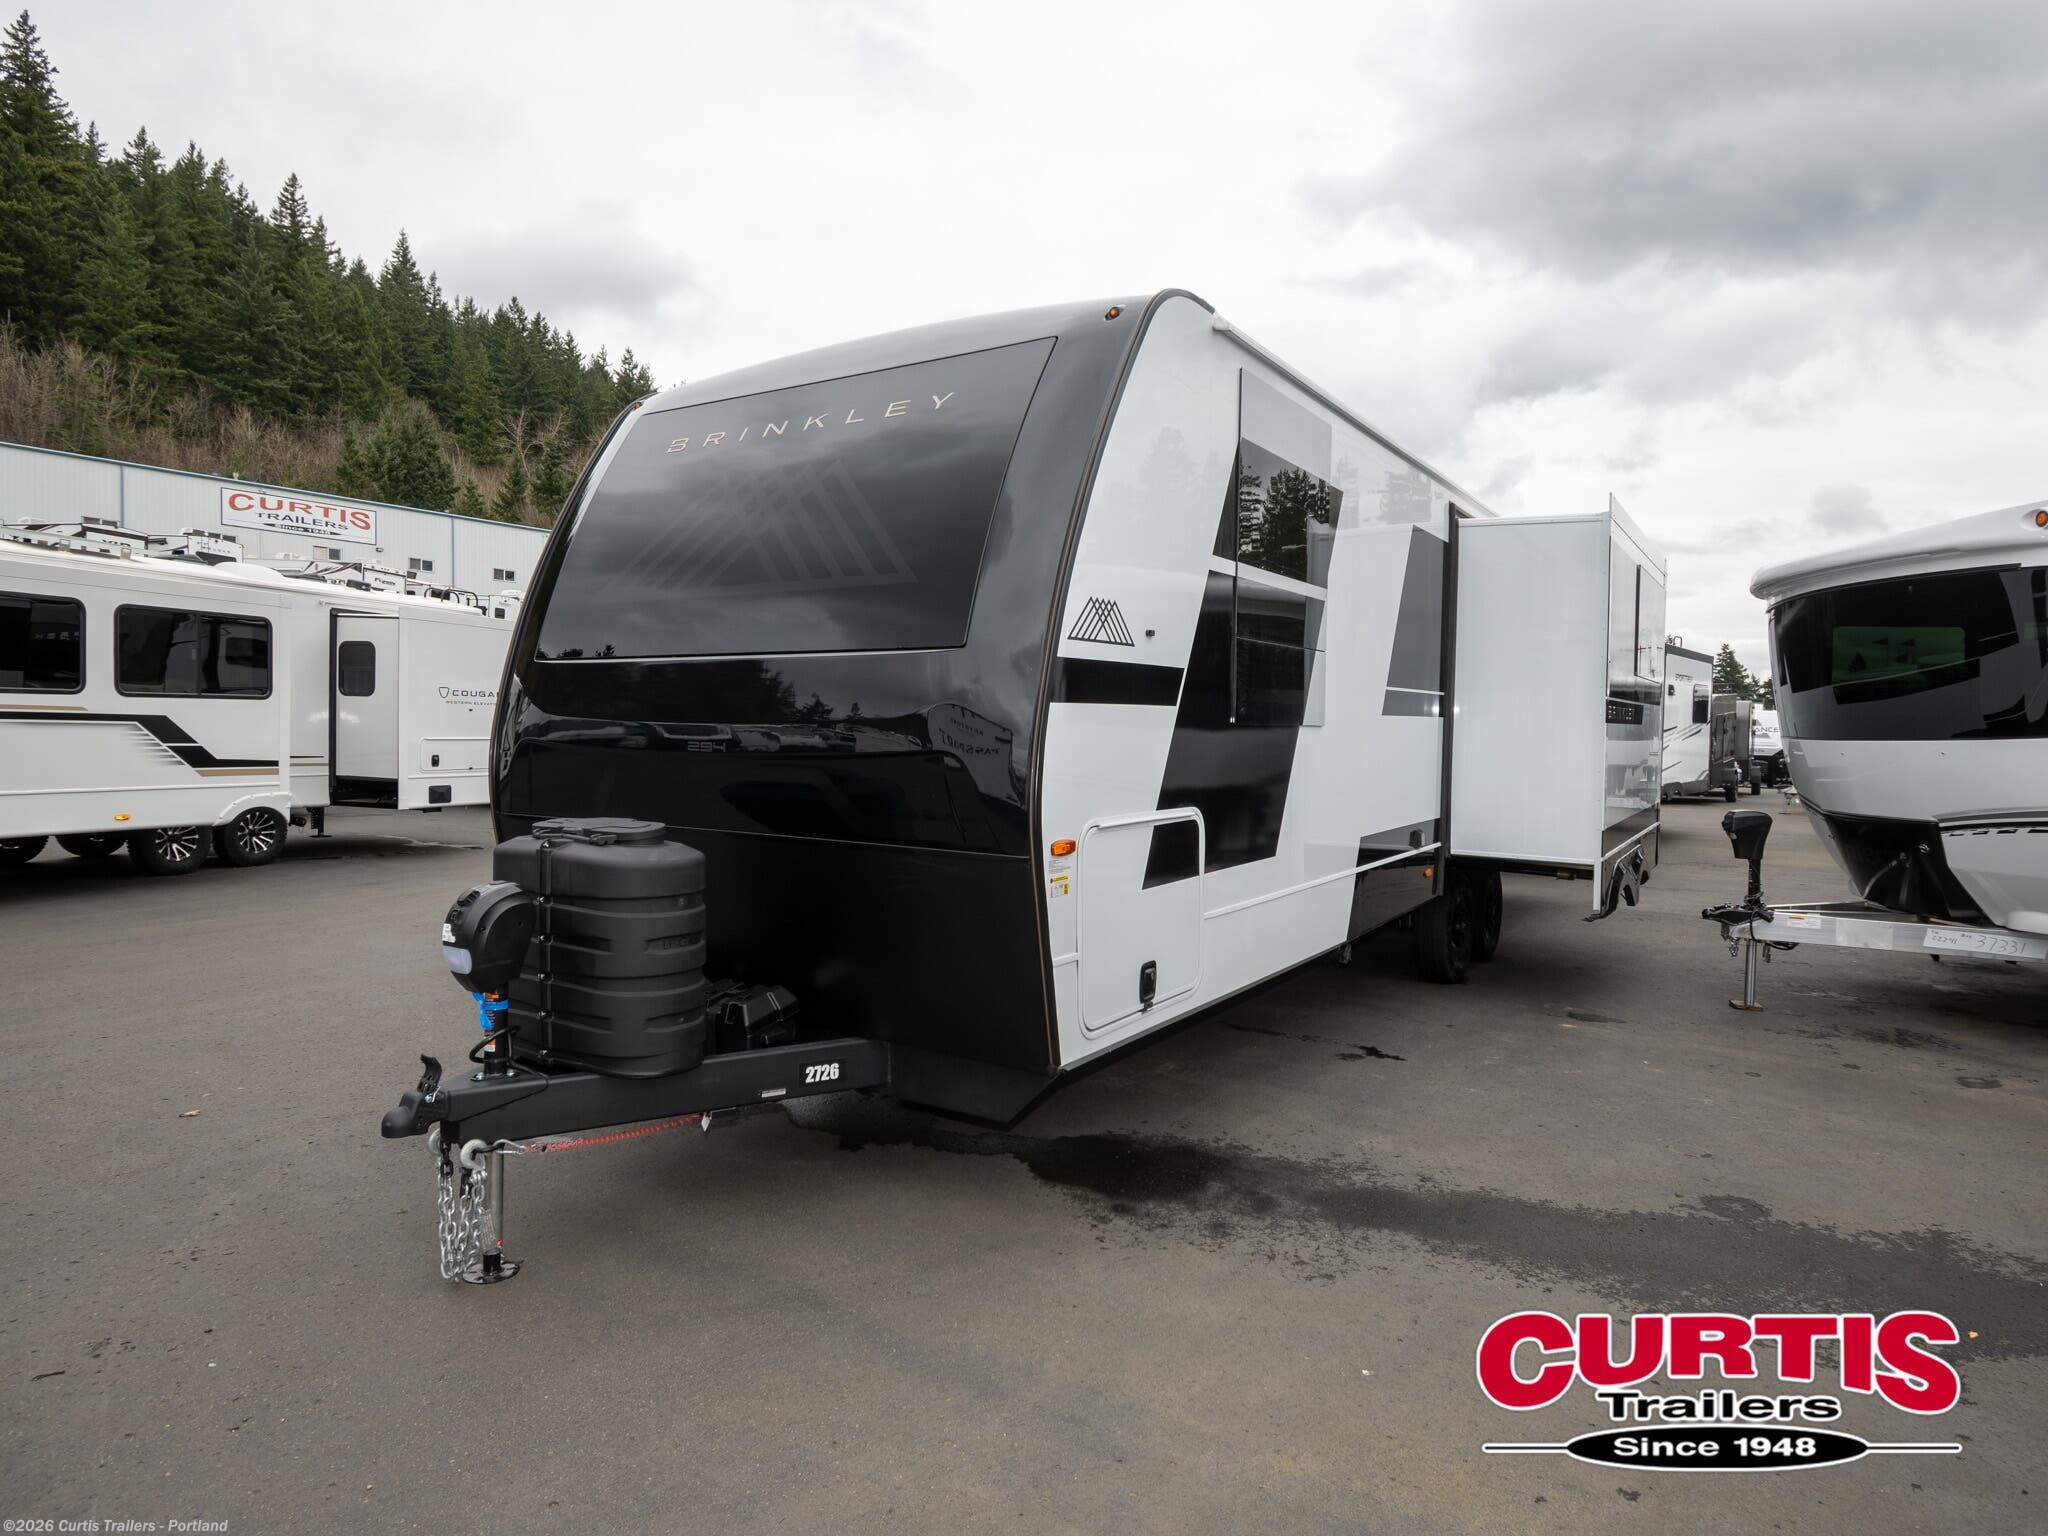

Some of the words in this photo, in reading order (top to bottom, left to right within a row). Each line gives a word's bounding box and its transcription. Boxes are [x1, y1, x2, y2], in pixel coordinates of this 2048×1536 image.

[667, 391, 955, 453] BRINKLEY
[228, 493, 371, 531] CURTIS
[256, 512, 349, 530] TRAILERS
[452, 689, 499, 698] COUGA
[805, 1062, 840, 1084] 2726
